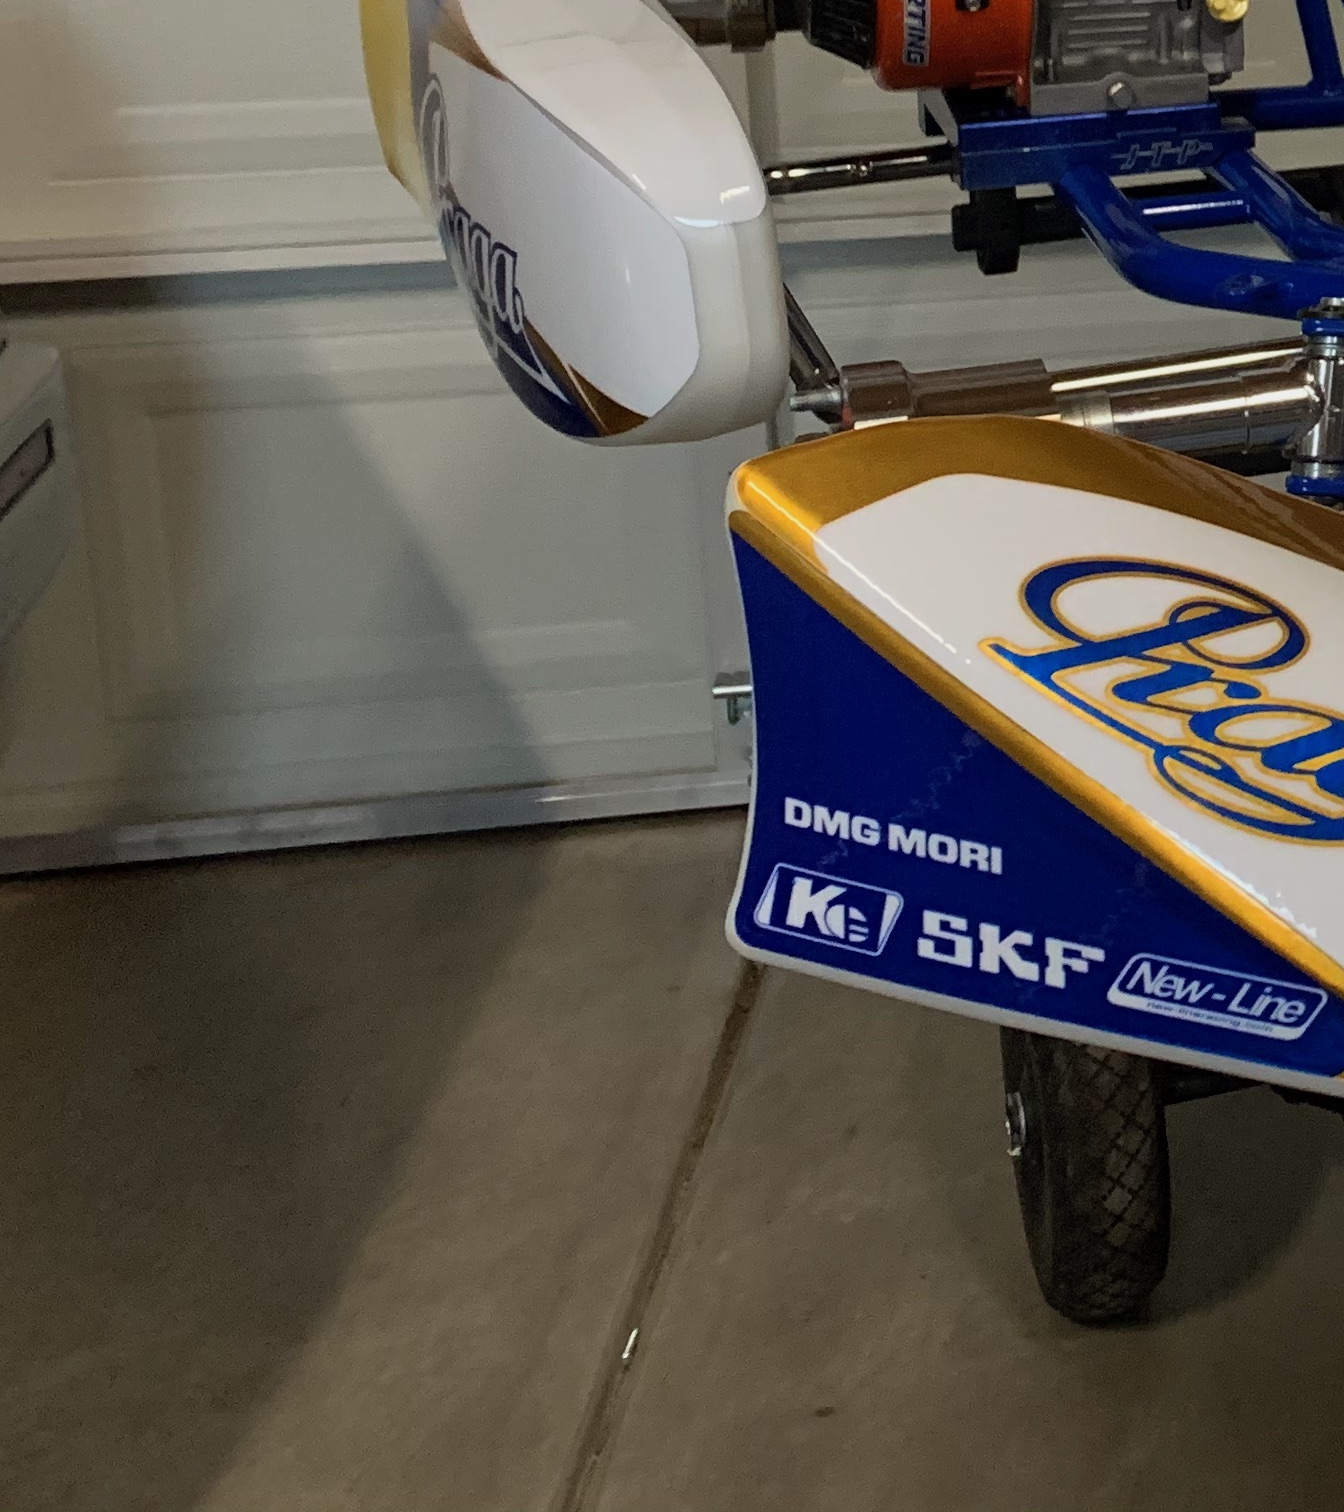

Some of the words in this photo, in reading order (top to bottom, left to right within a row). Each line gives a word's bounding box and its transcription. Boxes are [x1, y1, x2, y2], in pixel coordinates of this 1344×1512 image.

[783, 795, 881, 847] DMG
[887, 822, 1003, 876] MORI
[916, 908, 1106, 990] SKF
